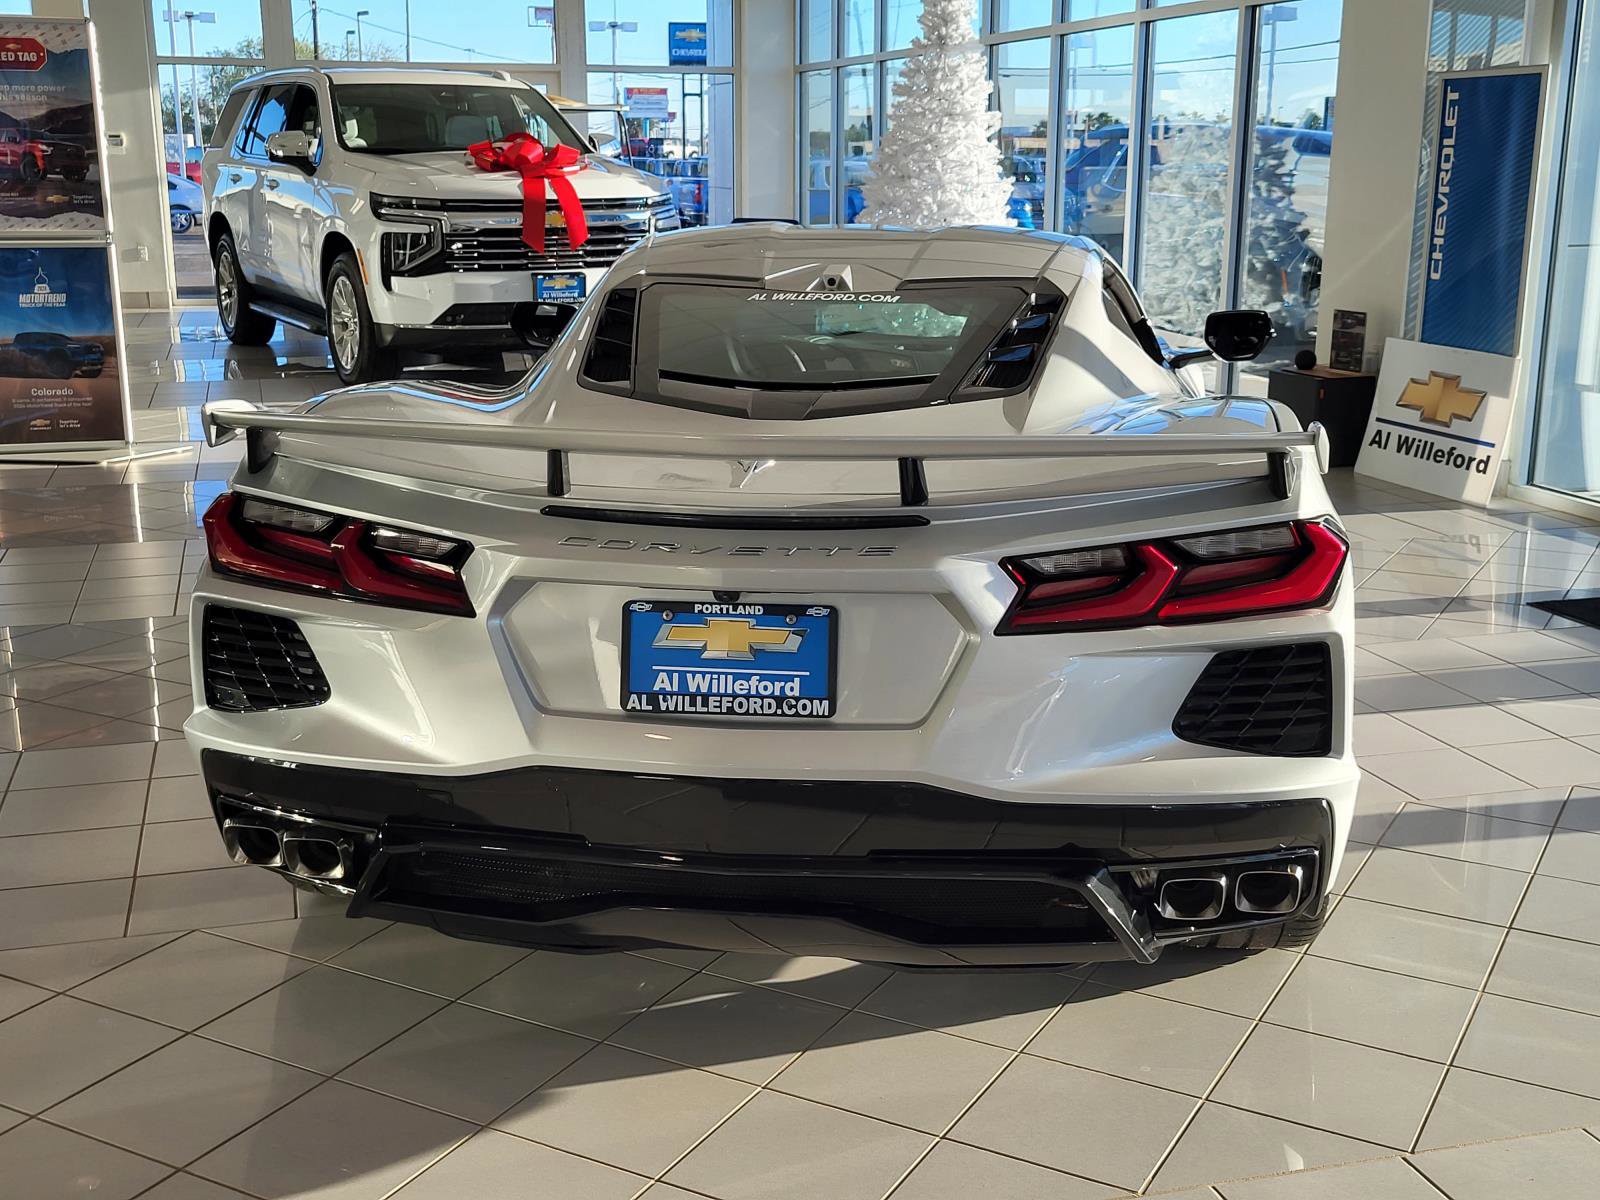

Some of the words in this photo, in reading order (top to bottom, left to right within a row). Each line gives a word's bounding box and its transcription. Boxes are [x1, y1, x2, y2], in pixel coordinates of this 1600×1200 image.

[0, 52, 15, 61] ED
[17, 52, 38, 61] TAG
[37, 85, 66, 93] power
[1430, 86, 1460, 280] CHEVROLET
[19, 293, 67, 303] MOTORTREND
[747, 293, 767, 301] AL
[772, 292, 901, 303] WILLEFORD.COM
[31, 387, 74, 396] Colorado
[1368, 429, 1391, 450] Al
[1396, 434, 1491, 474] Willeford
[558, 536, 899, 557] CORVETTE
[694, 604, 764, 615] PORTLAND
[653, 672, 678, 691] Al
[686, 673, 800, 697] Willeford
[626, 694, 653, 710] AL
[658, 694, 830, 716] WILLEFORD.COM
